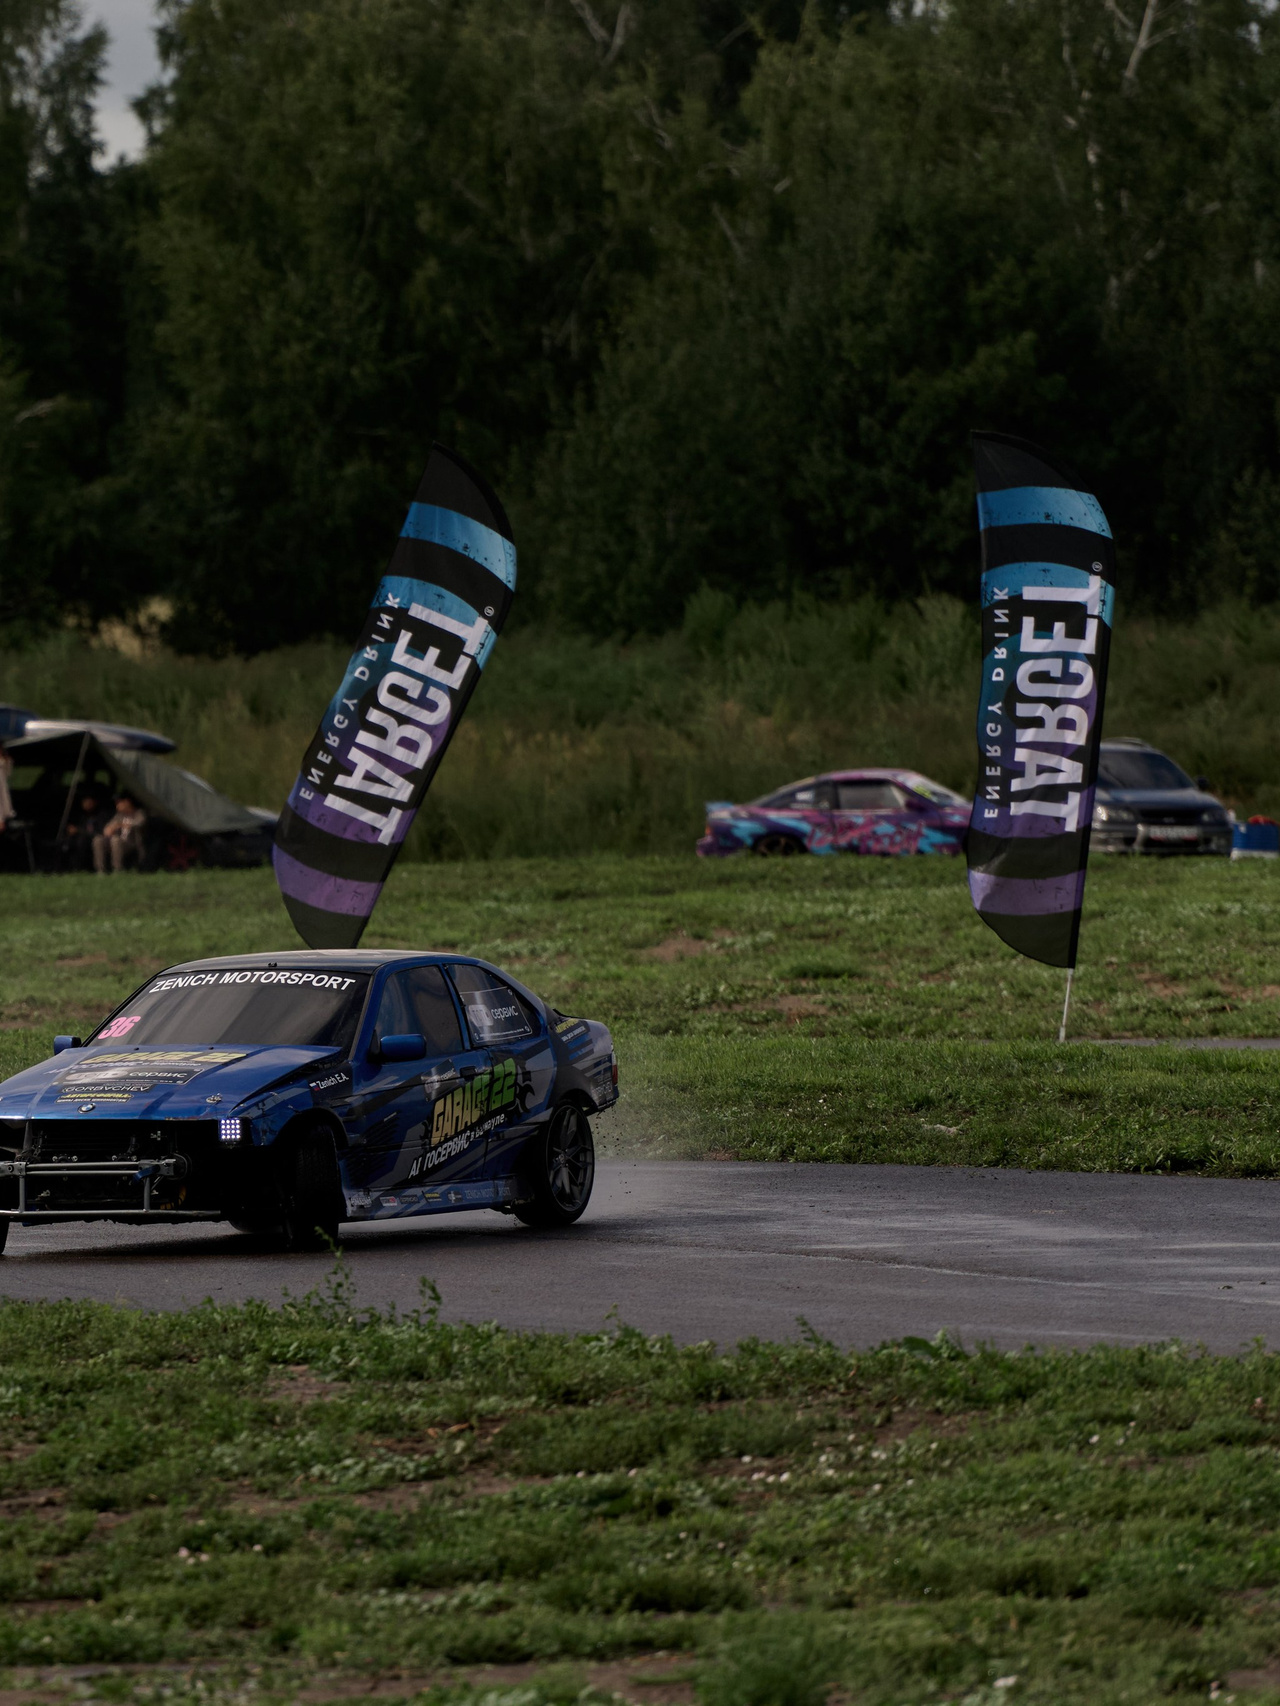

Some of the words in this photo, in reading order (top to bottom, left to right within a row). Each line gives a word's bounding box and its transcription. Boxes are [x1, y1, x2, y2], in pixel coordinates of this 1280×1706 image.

[149, 973, 219, 993] ZENICH
[219, 971, 356, 991] MOTORSPORT
[98, 1015, 141, 1040] 36
[490, 1057, 517, 1111] 22
